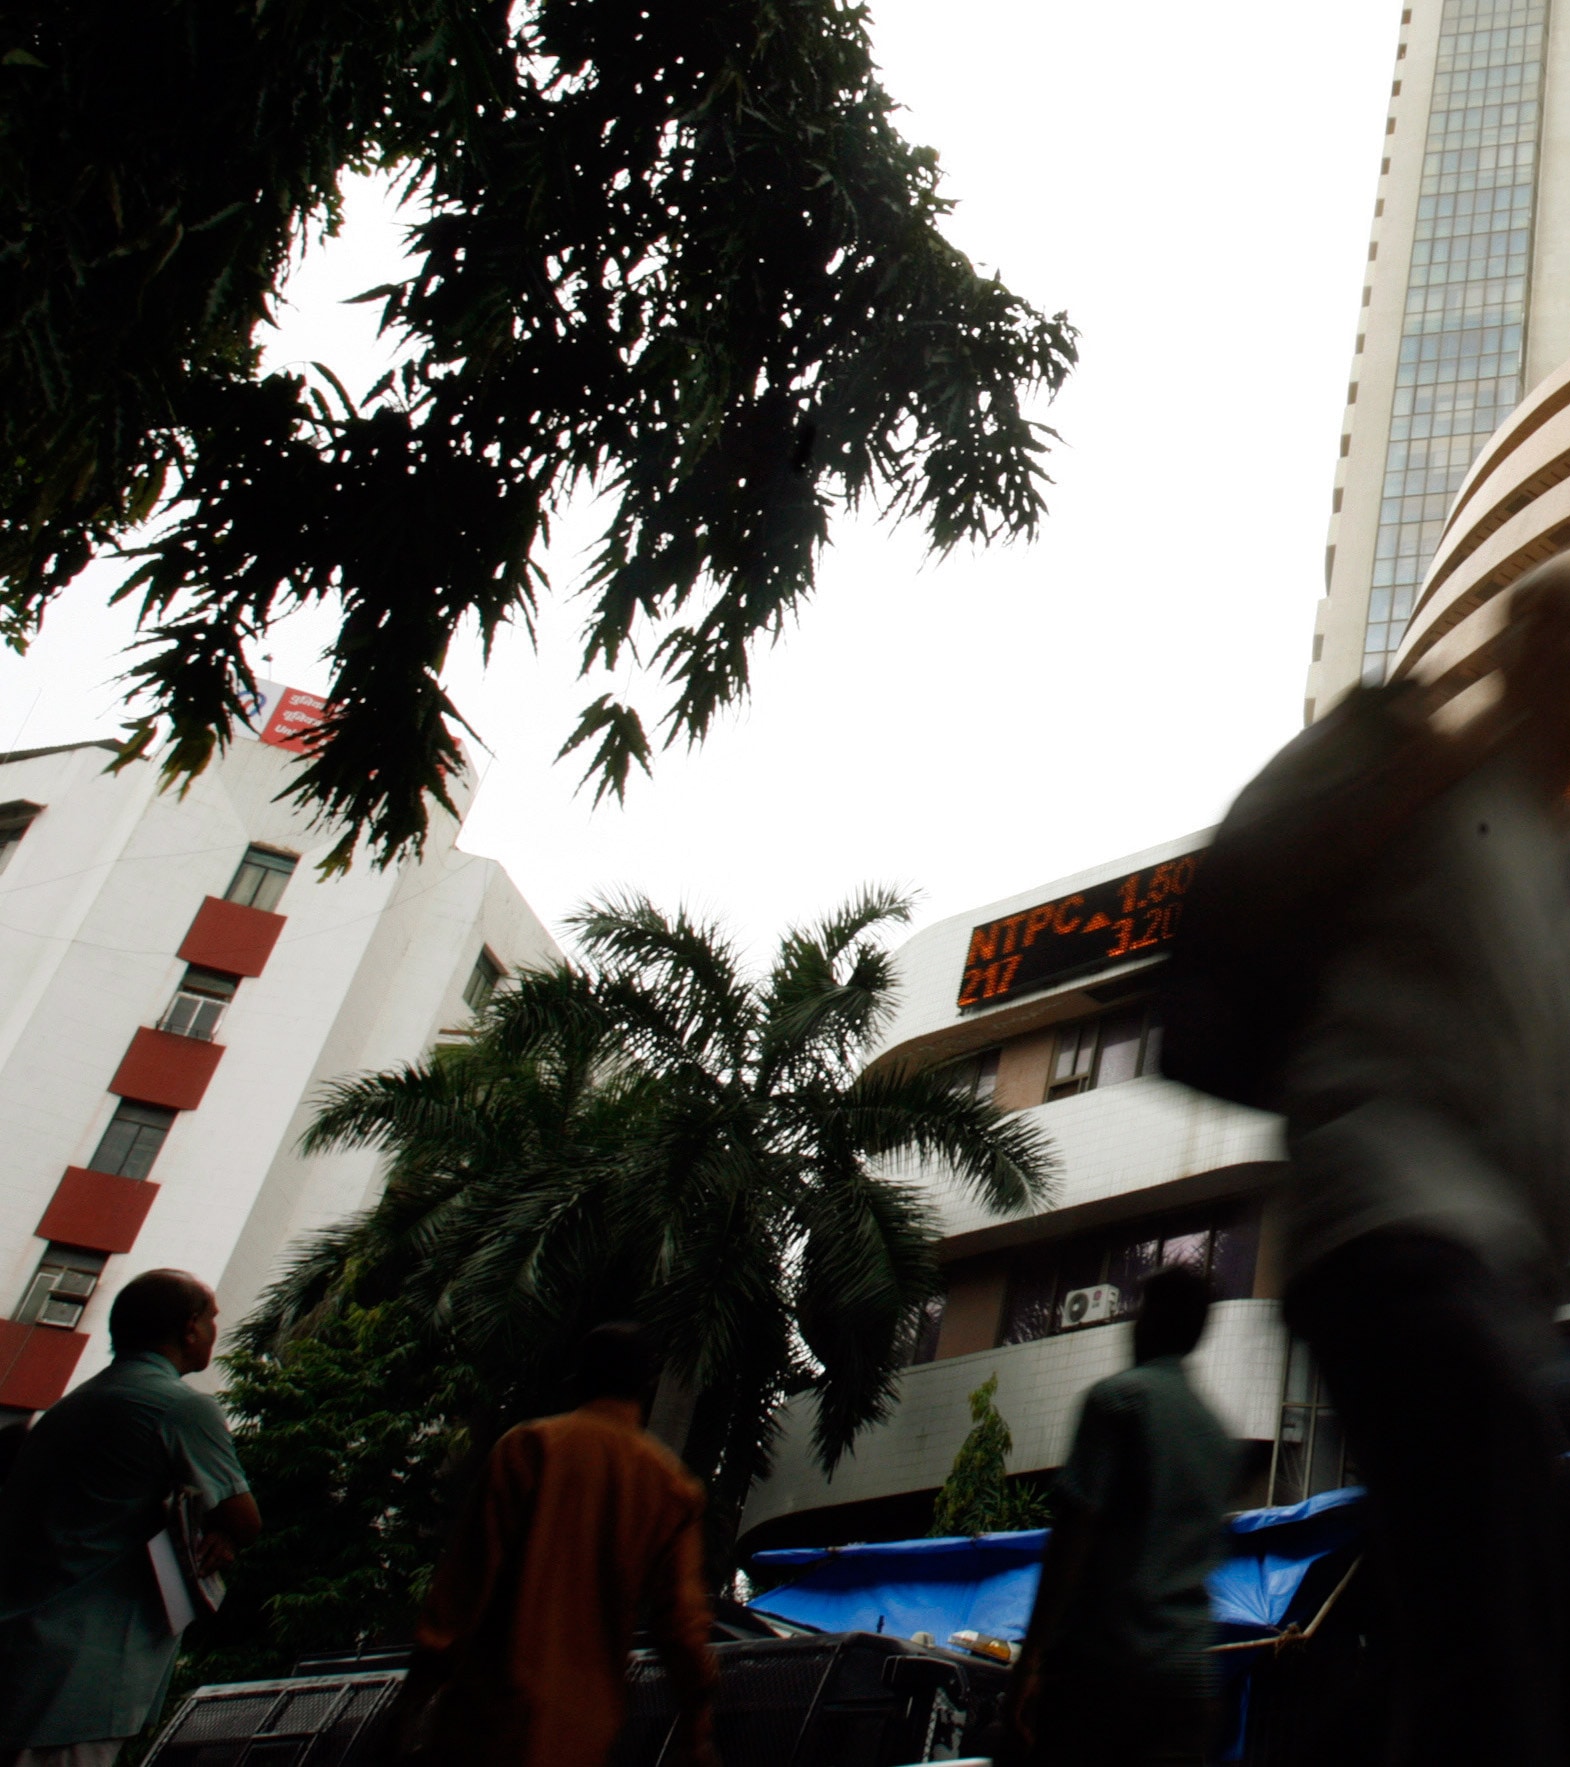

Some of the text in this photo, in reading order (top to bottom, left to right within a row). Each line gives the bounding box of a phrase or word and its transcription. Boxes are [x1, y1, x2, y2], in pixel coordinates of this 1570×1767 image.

[967, 856, 1197, 966] NTPC 1.50
[957, 954, 1023, 1006] 217
